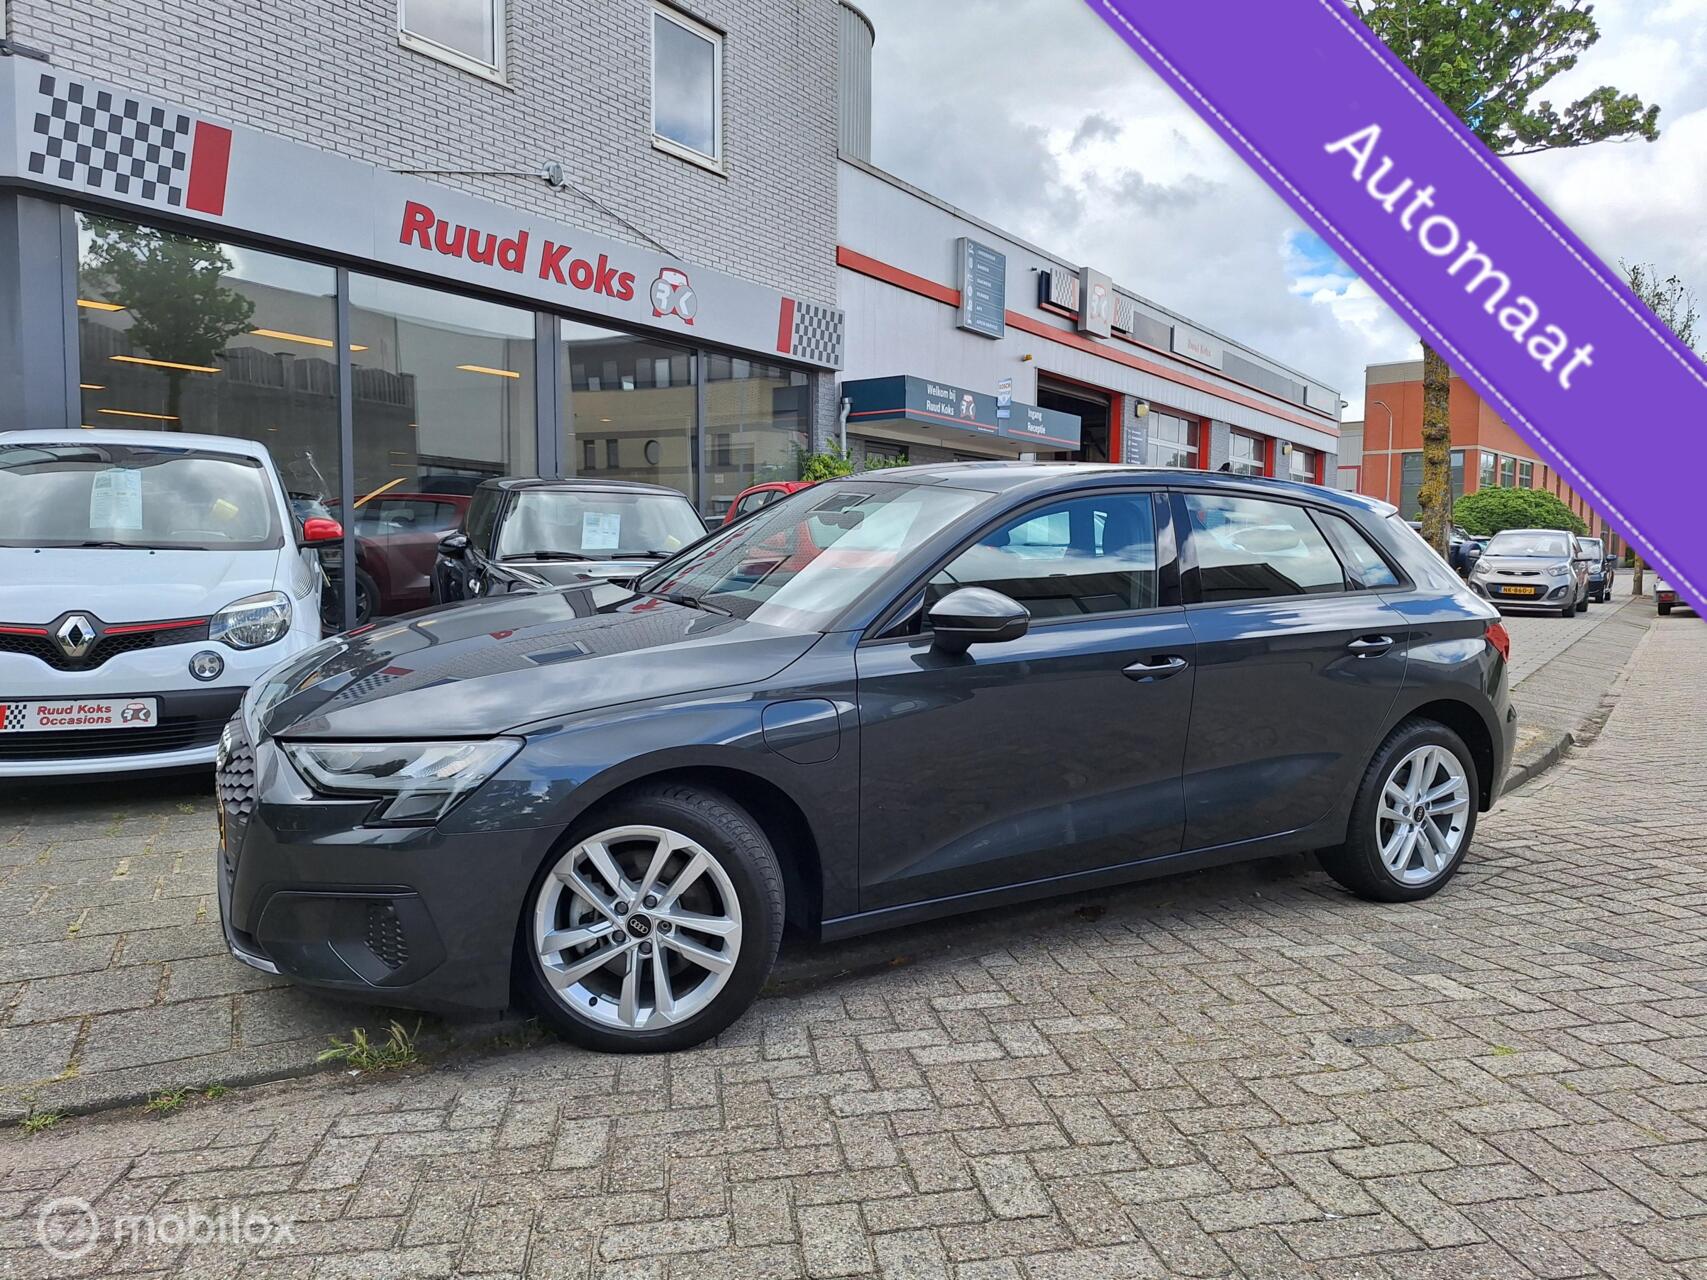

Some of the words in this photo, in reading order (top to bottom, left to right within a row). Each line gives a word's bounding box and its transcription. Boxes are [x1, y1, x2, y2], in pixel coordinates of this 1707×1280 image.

[399, 200, 529, 273] Ruud
[538, 240, 636, 302] Koks
[926, 384, 949, 399] Welkom
[949, 388, 957, 403] bij
[926, 400, 941, 414] Ruud
[941, 402, 954, 416] Koks
[1027, 408, 1042, 421] Ingang
[1027, 422, 1046, 435] Receptie
[37, 705, 73, 716] Ruud
[77, 703, 112, 715] Koks
[39, 714, 112, 726] Occasions
